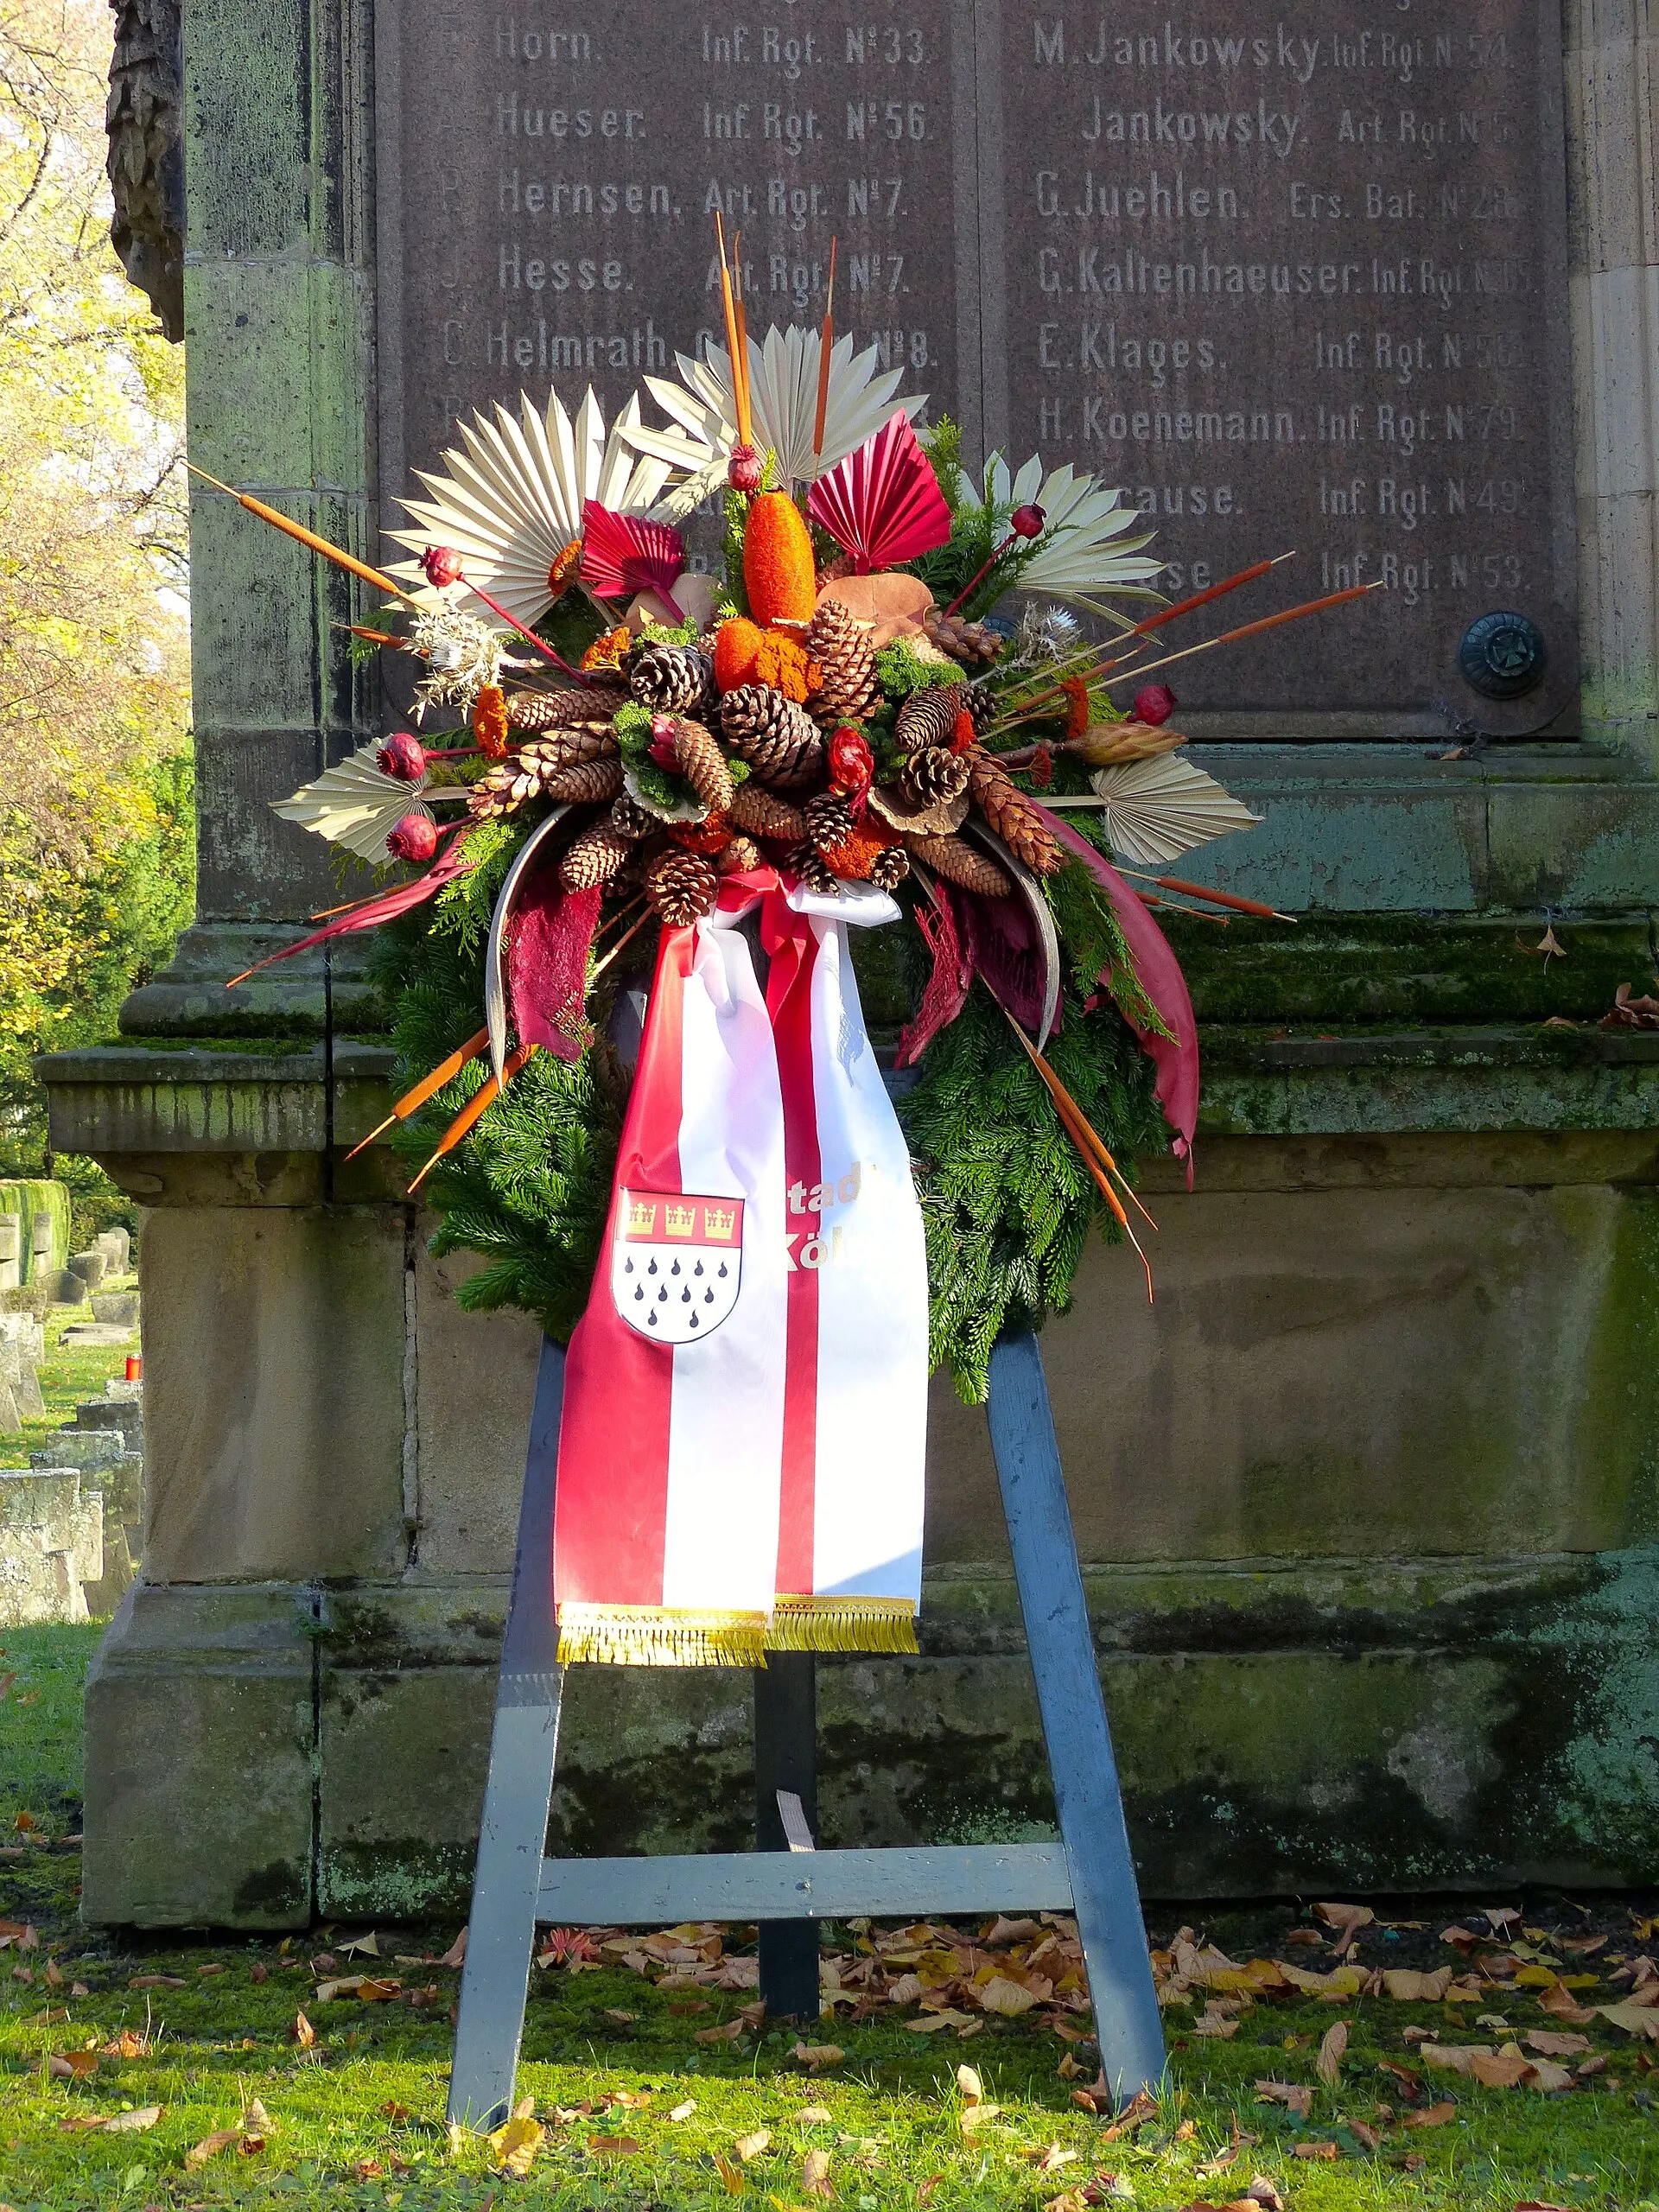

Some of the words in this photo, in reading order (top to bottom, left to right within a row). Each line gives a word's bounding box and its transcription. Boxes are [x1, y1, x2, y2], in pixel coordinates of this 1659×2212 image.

[494, 16, 602, 61] Horn.
[498, 91, 646, 138] Hueser.
[1081, 93, 1309, 158] Jankowsky.
[497, 168, 682, 217] Hernsen.
[499, 243, 634, 291] Hesse.
[705, 254, 759, 292] At.
[487, 316, 678, 369] Helmrath.
[1115, 484, 1243, 516] rause.
[787, 1161, 862, 1215] tad
